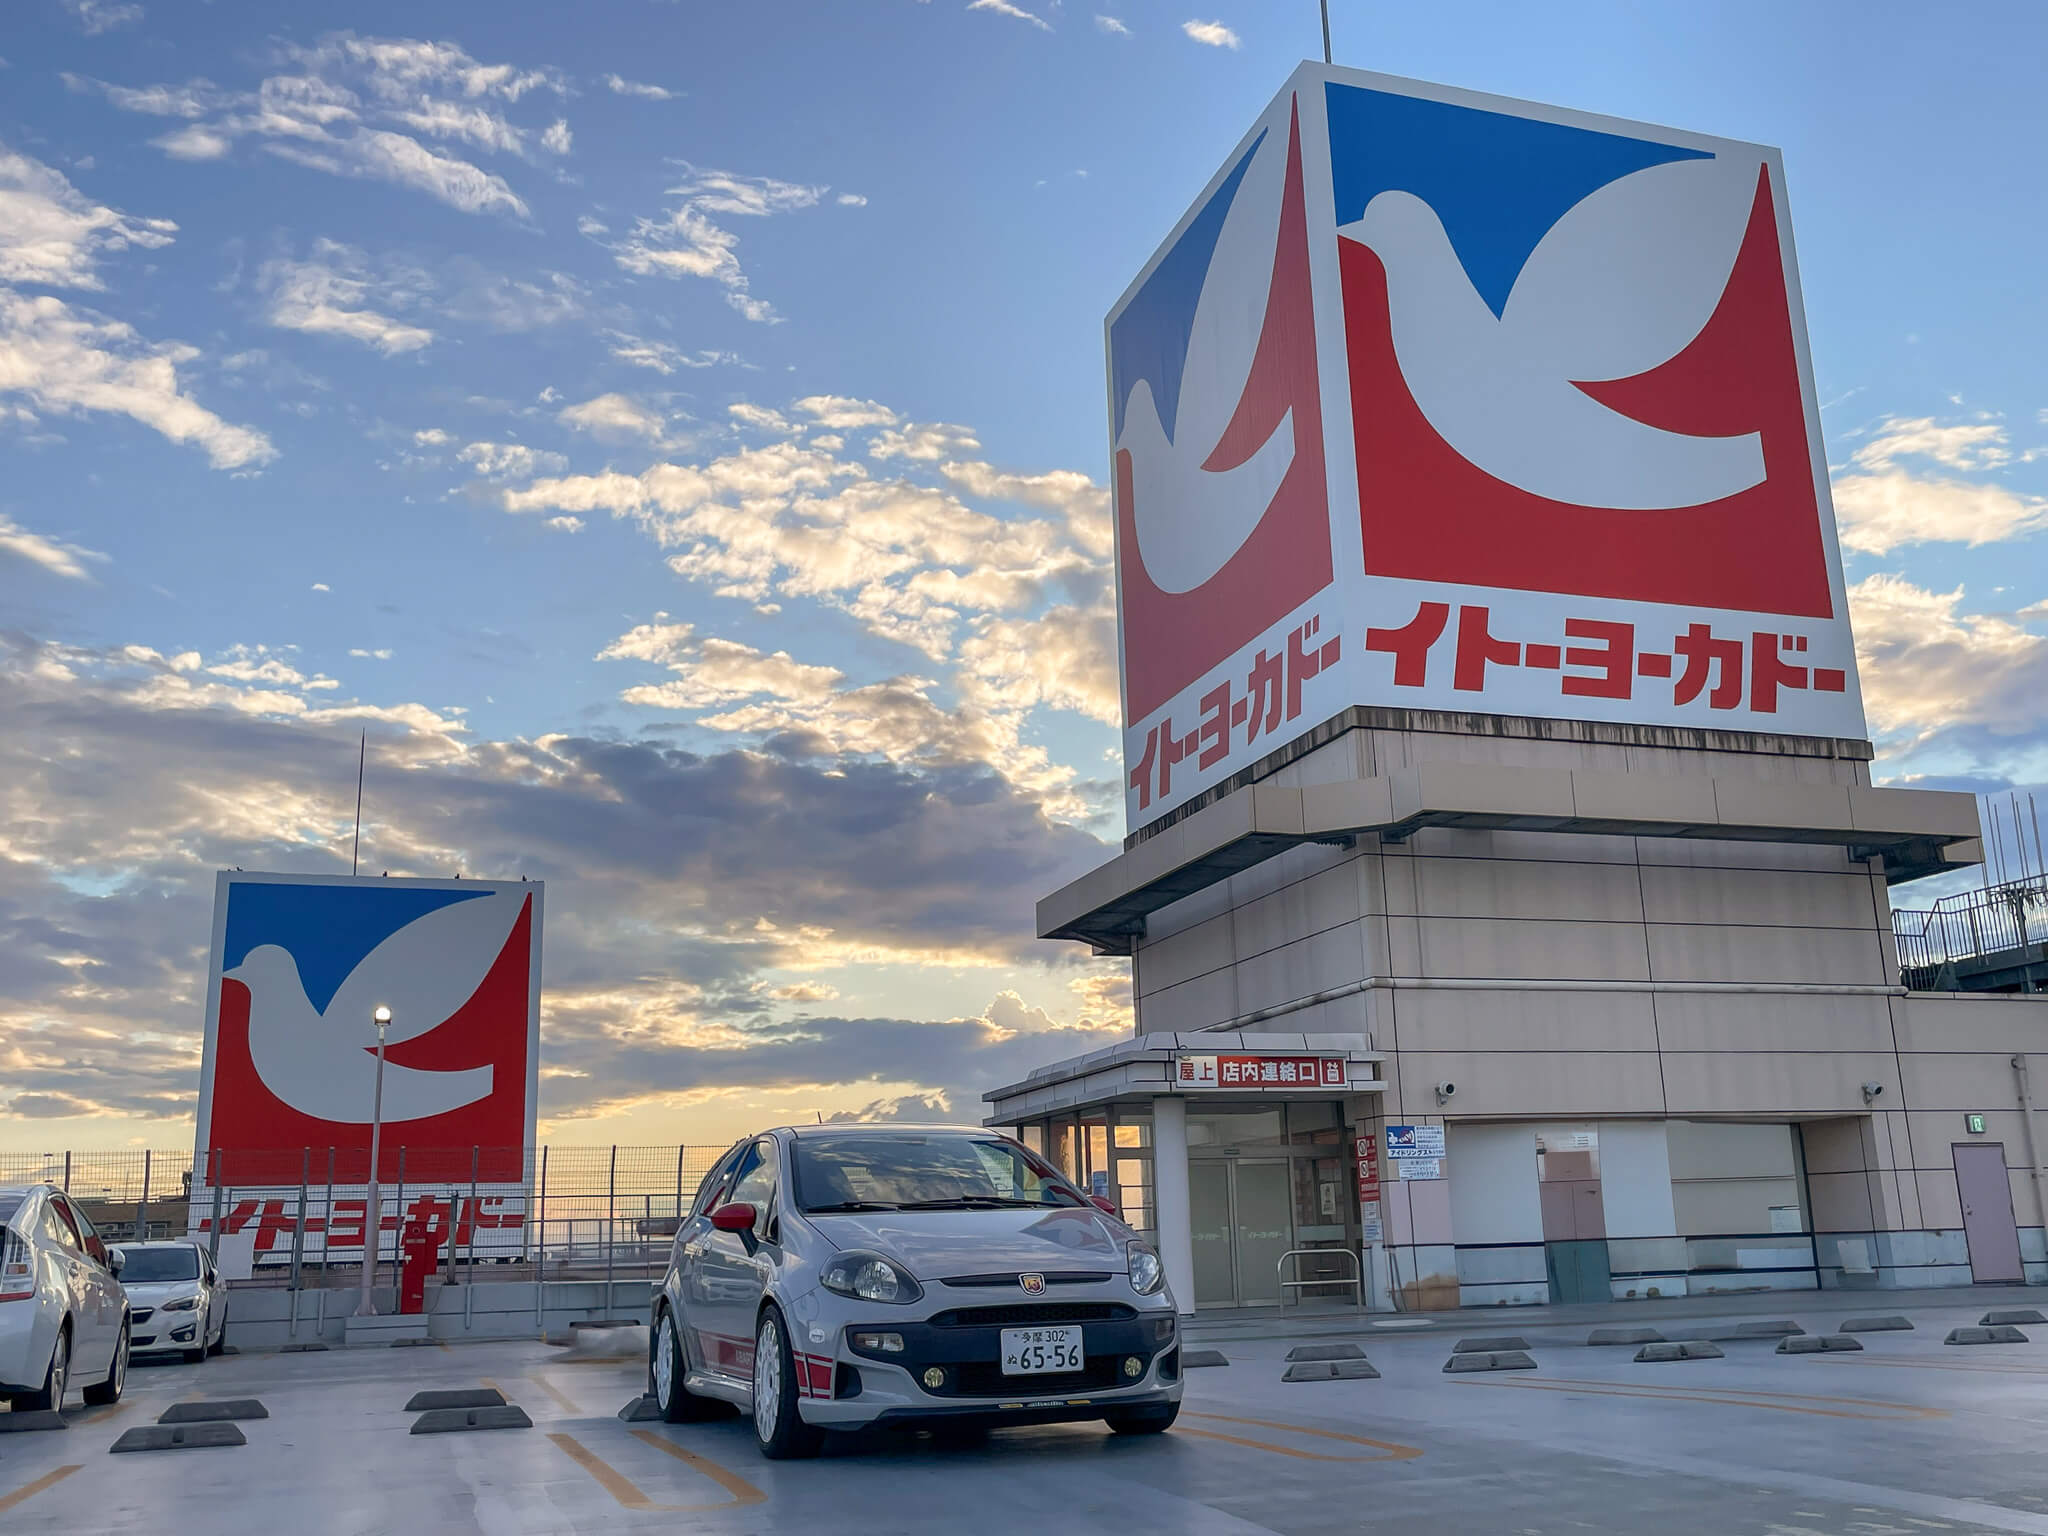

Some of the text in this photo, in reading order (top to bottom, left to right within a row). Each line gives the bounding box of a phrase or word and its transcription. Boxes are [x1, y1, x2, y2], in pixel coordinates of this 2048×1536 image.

[1365, 601, 1846, 714] イトーヨーカドー
[1130, 614, 1341, 811] イトーヨーカドー
[1180, 1060, 1315, 1082] 屋上 店内連絡口
[1022, 1329, 1065, 1343] 多摩 302
[1007, 1344, 1079, 1370] ぬ 65-56
